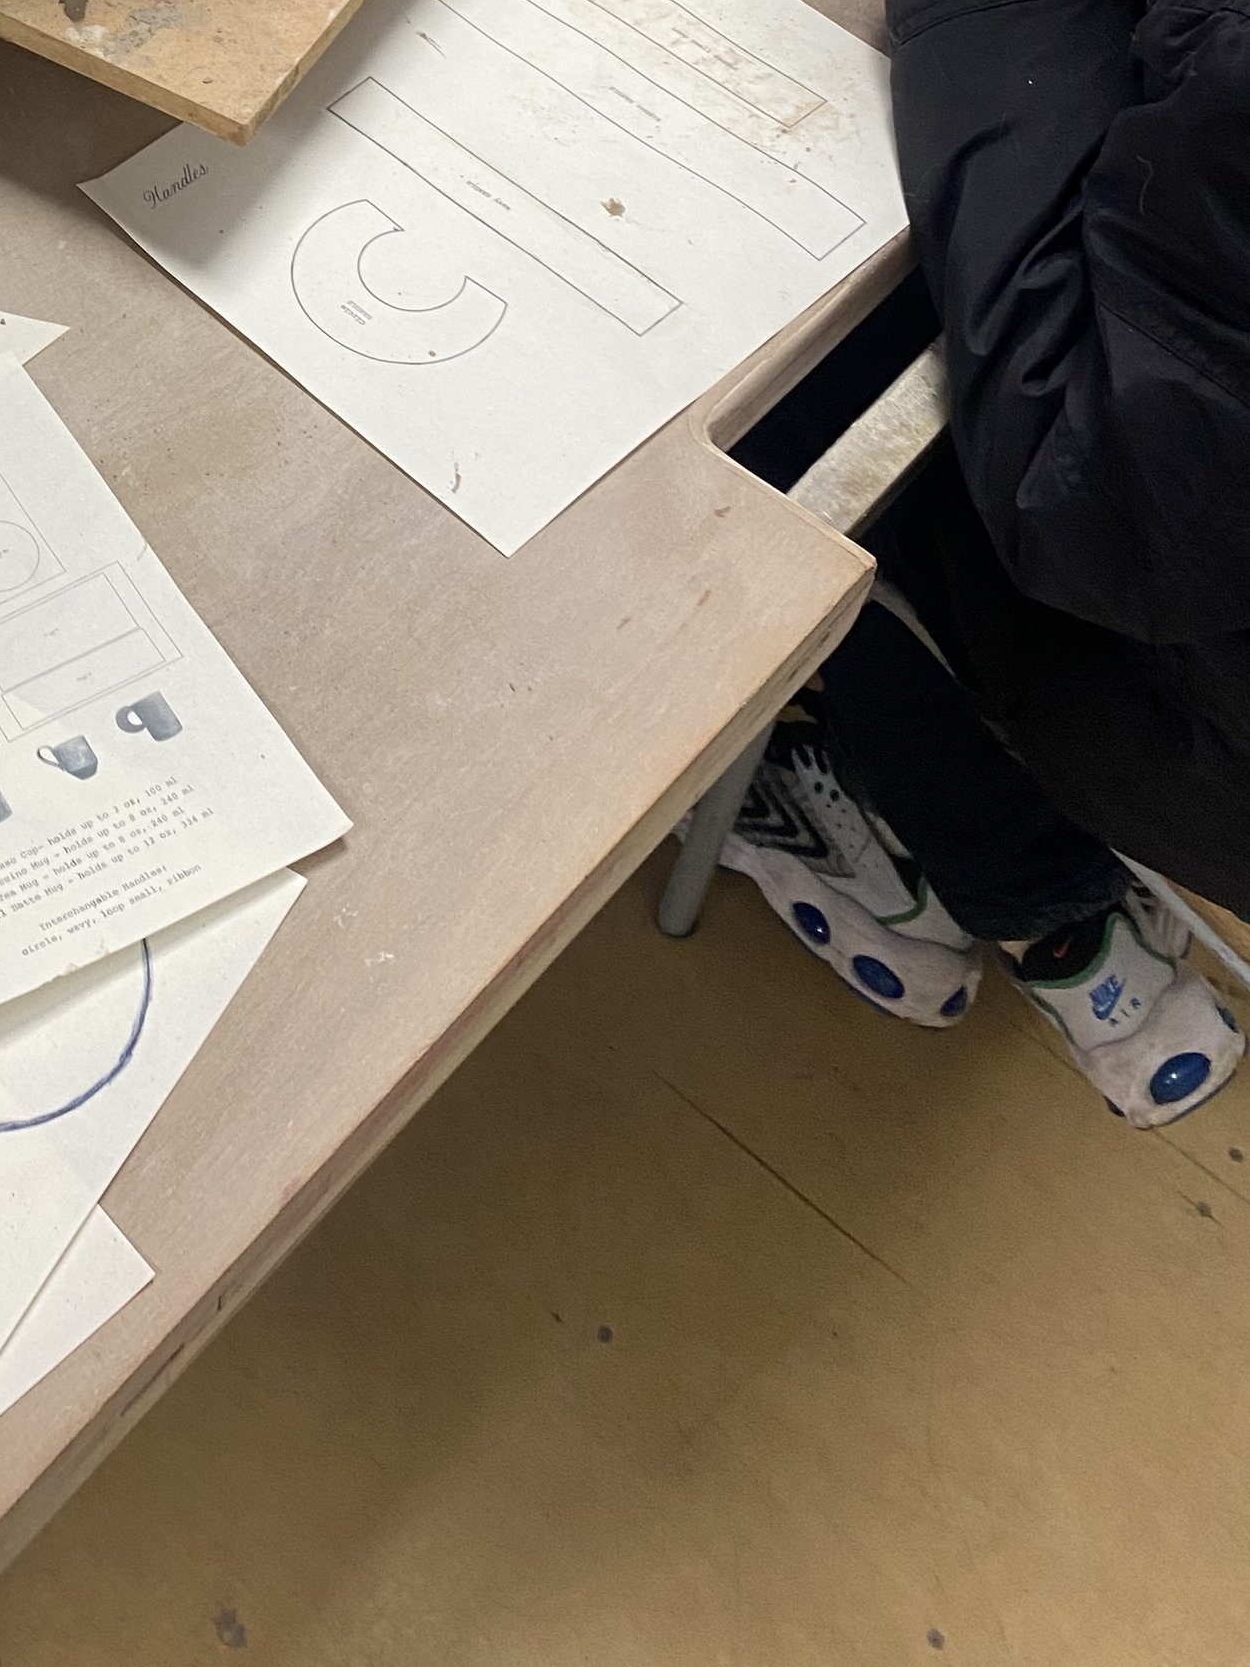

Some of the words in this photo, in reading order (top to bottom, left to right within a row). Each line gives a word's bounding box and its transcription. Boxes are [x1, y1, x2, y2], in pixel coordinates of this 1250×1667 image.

[143, 163, 209, 210] Handles
[19, 879, 40, 893] Mug
[52, 857, 84, 877] holds
[85, 850, 100, 860] up
[102, 841, 116, 852] to
[150, 814, 170, 828] 240
[172, 806, 185, 818] ml
[30, 857, 51, 872] Mug
[62, 836, 94, 855] holds
[97, 828, 110, 839] up
[112, 820, 127, 830] to
[160, 792, 179, 807] 240
[181, 784, 195, 797] ml
[46, 828, 78, 847] holds
[80, 820, 94, 831] up
[96, 812, 110, 823] to
[164, 776, 178, 789] ml
[43, 883, 65, 897] Mug
[76, 861, 109, 881] holds
[110, 854, 125, 864] up
[127, 845, 141, 856] to
[201, 807, 215, 820] ml
[66, 918, 97, 935] wavy,
[100, 903, 126, 919] loop
[166, 864, 202, 887] ribbon
